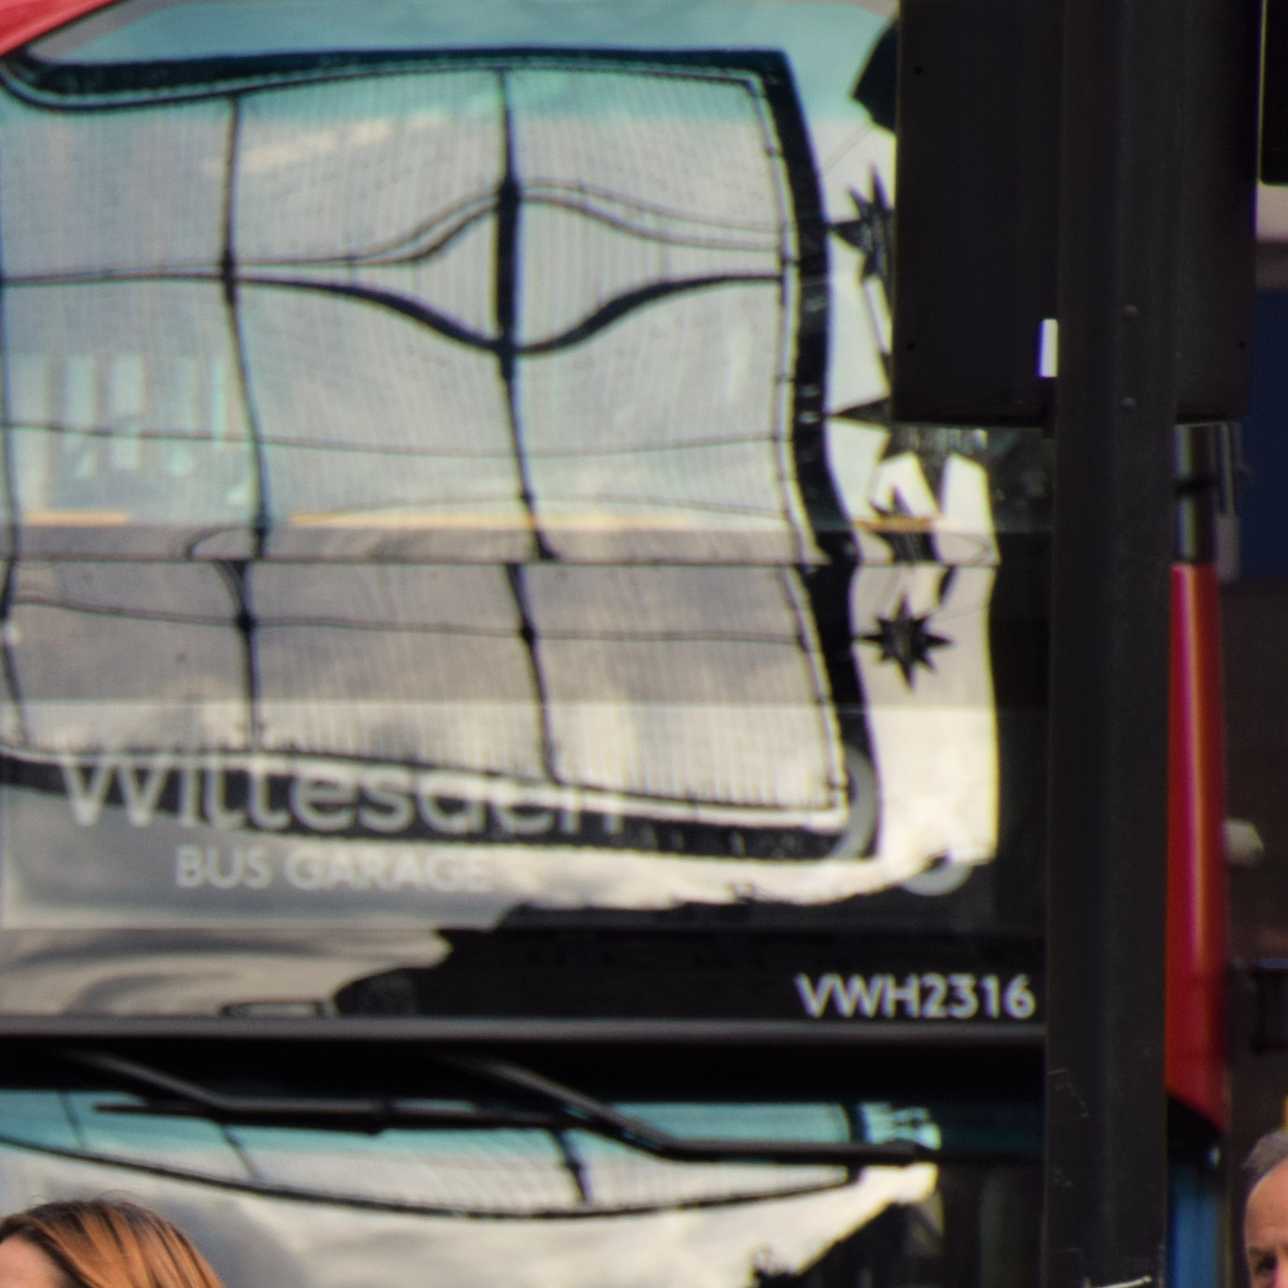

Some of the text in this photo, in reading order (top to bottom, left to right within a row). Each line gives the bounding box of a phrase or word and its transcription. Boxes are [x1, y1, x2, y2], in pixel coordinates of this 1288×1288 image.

[174, 844, 491, 892] BUS GARAGE
[794, 972, 1038, 1020] VWH2316
